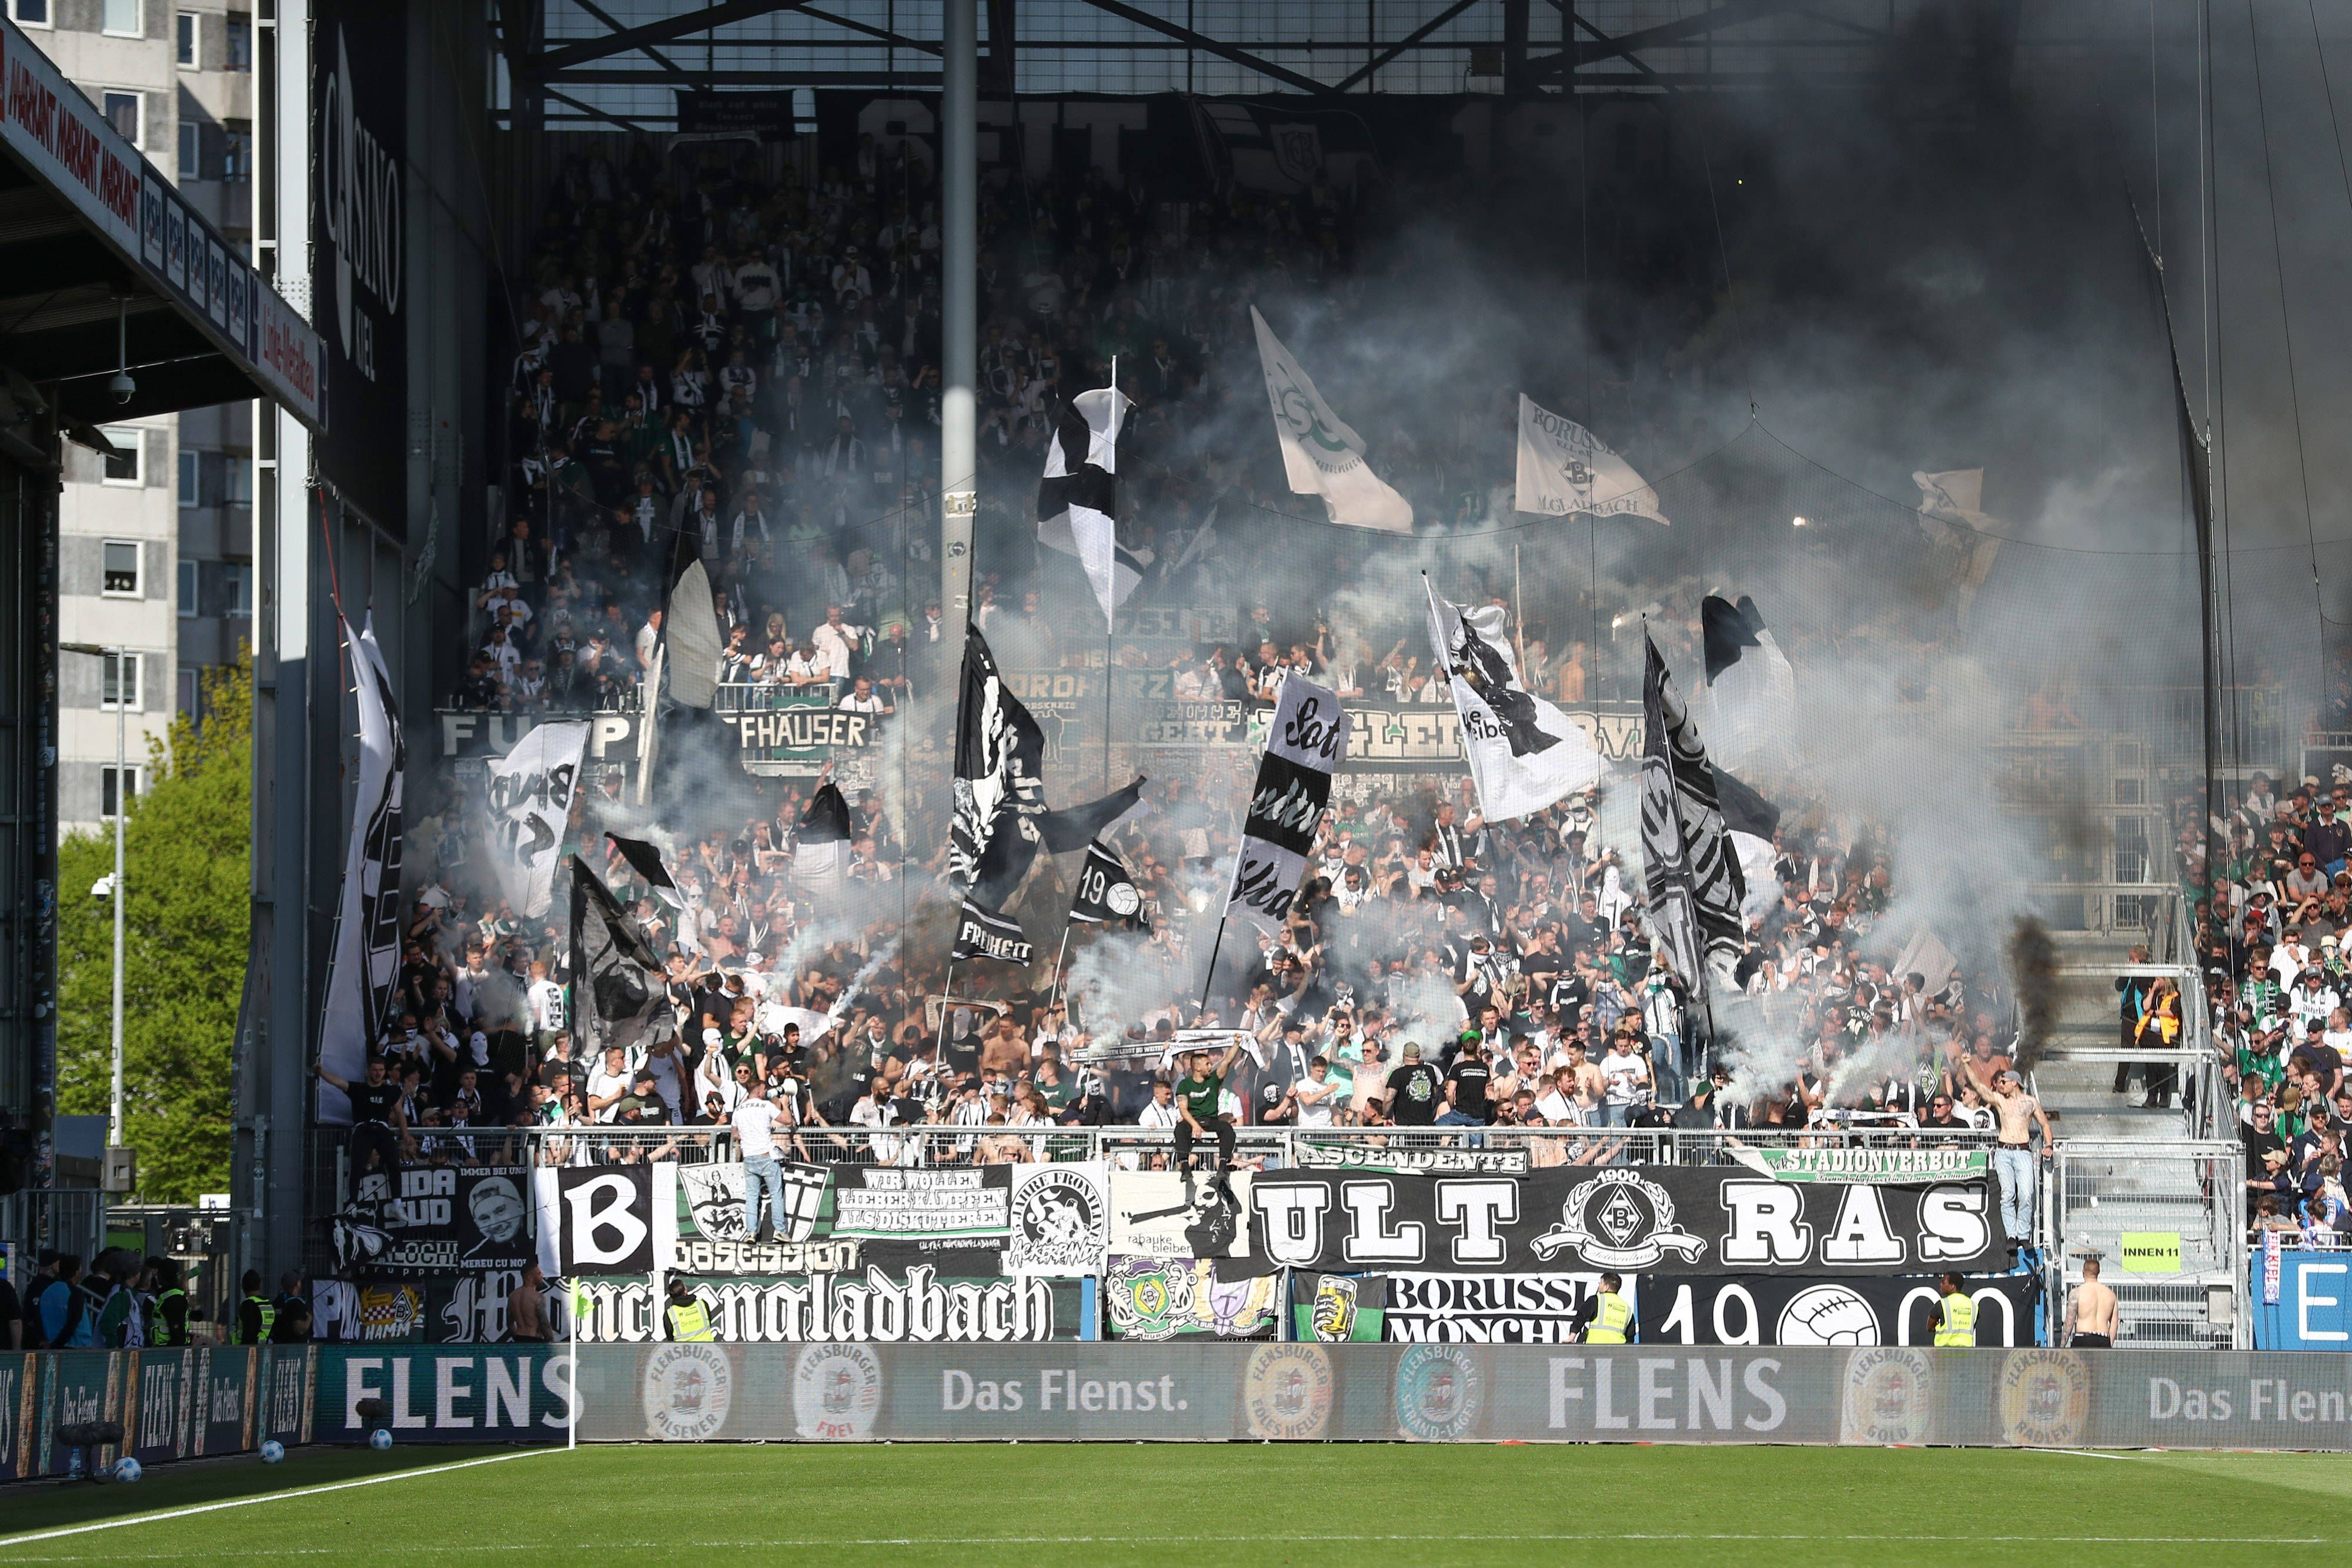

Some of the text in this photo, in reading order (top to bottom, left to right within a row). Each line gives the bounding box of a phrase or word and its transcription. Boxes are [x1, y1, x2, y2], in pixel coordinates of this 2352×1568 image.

[9, 57, 139, 233] MARKANT MARKANT MARKANT
[324, 72, 400, 315] CASINO
[356, 305, 376, 383] KIEL
[1004, 673, 1169, 698] ORDHARZ
[724, 711, 866, 748] FHÄUSER
[460, 1166, 527, 1176] IMMER BEI UNS
[1298, 1147, 1527, 1174] ASCENDENTE
[1596, 1169, 1641, 1185] 1900
[1786, 1150, 1972, 1172] STADIONVERBOT
[863, 1168, 983, 1191] WIR WOLLEN
[838, 1189, 911, 1209] LIEBER
[1013, 1175, 1049, 1219] JAHRE
[1053, 1172, 1102, 1242] FRONTLINE
[2327, 1195, 2337, 1216] KIEL
[564, 1174, 649, 1266] B
[836, 1207, 1008, 1231] ALS DISKUTIEREN
[1009, 1236, 1105, 1268] ACKERBANDE
[1128, 1234, 1172, 1244] rabauke
[2123, 1246, 2179, 1258] INNEN 11
[360, 1266, 440, 1276] gruppe
[460, 1259, 494, 1269] MEREU
[495, 1259, 510, 1268] CU
[2267, 1255, 2279, 1283] KIEL
[441, 1265, 1057, 1343] Mncngladbach
[1388, 1279, 1590, 1312] BORUSSI
[365, 1322, 410, 1340] HAMM
[651, 1345, 728, 1388] FLENSBURGER
[800, 1345, 876, 1389] FLENSBURGER
[1254, 1345, 1331, 1388] FLENSBURGER
[1404, 1345, 1478, 1388] FLENSBURGER
[1853, 1348, 1929, 1390] FLENSBURGER
[2006, 1349, 2087, 1393] FLENSBURGER
[76, 1385, 99, 1425] Flenst
[141, 1362, 175, 1449] FLENS
[346, 1358, 583, 1429] FLENS
[942, 1369, 1188, 1412] Das Flenst.
[1548, 1357, 1787, 1431] FLENS
[2149, 1377, 2232, 1422] Das
[654, 1410, 717, 1439] PILSENER
[816, 1420, 853, 1438] FREI
[1254, 1399, 1281, 1438] EDLES
[1402, 1392, 1477, 1440] STRAND-LAGER
[2014, 1421, 2073, 1445] RADLER
[1867, 1426, 1909, 1443] GOLD
